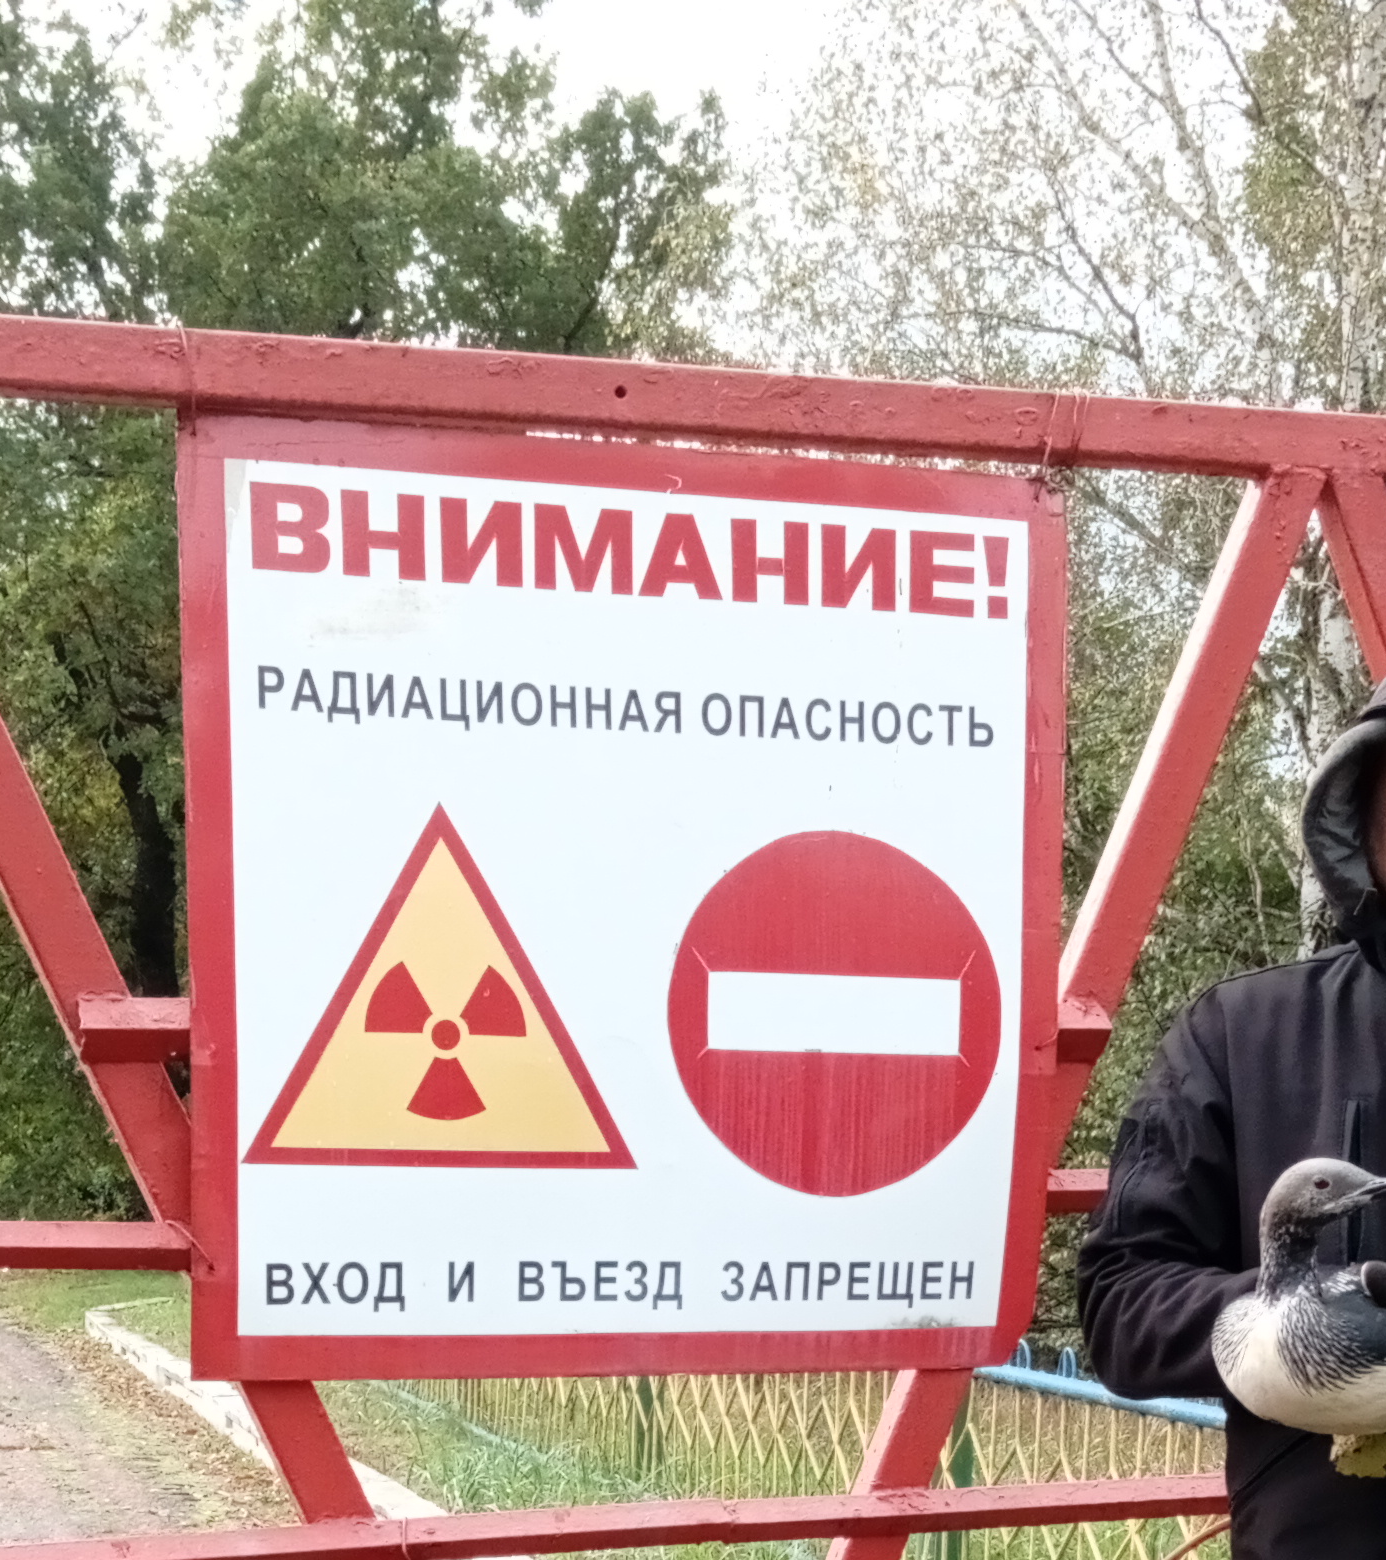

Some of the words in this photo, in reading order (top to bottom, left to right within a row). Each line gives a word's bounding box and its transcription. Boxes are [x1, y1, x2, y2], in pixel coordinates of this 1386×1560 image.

[249, 481, 1010, 620] ВНИМАНИЕ!
[257, 665, 682, 734] РАДИАЦИОННАЯ
[701, 692, 994, 748] ОПАСНОСТЬ
[266, 1261, 406, 1313] ВХОД
[448, 1261, 476, 1304] И
[518, 1260, 684, 1310] ВЪЕЗД
[720, 1260, 975, 1309] ЗАПРЕЩЕН
